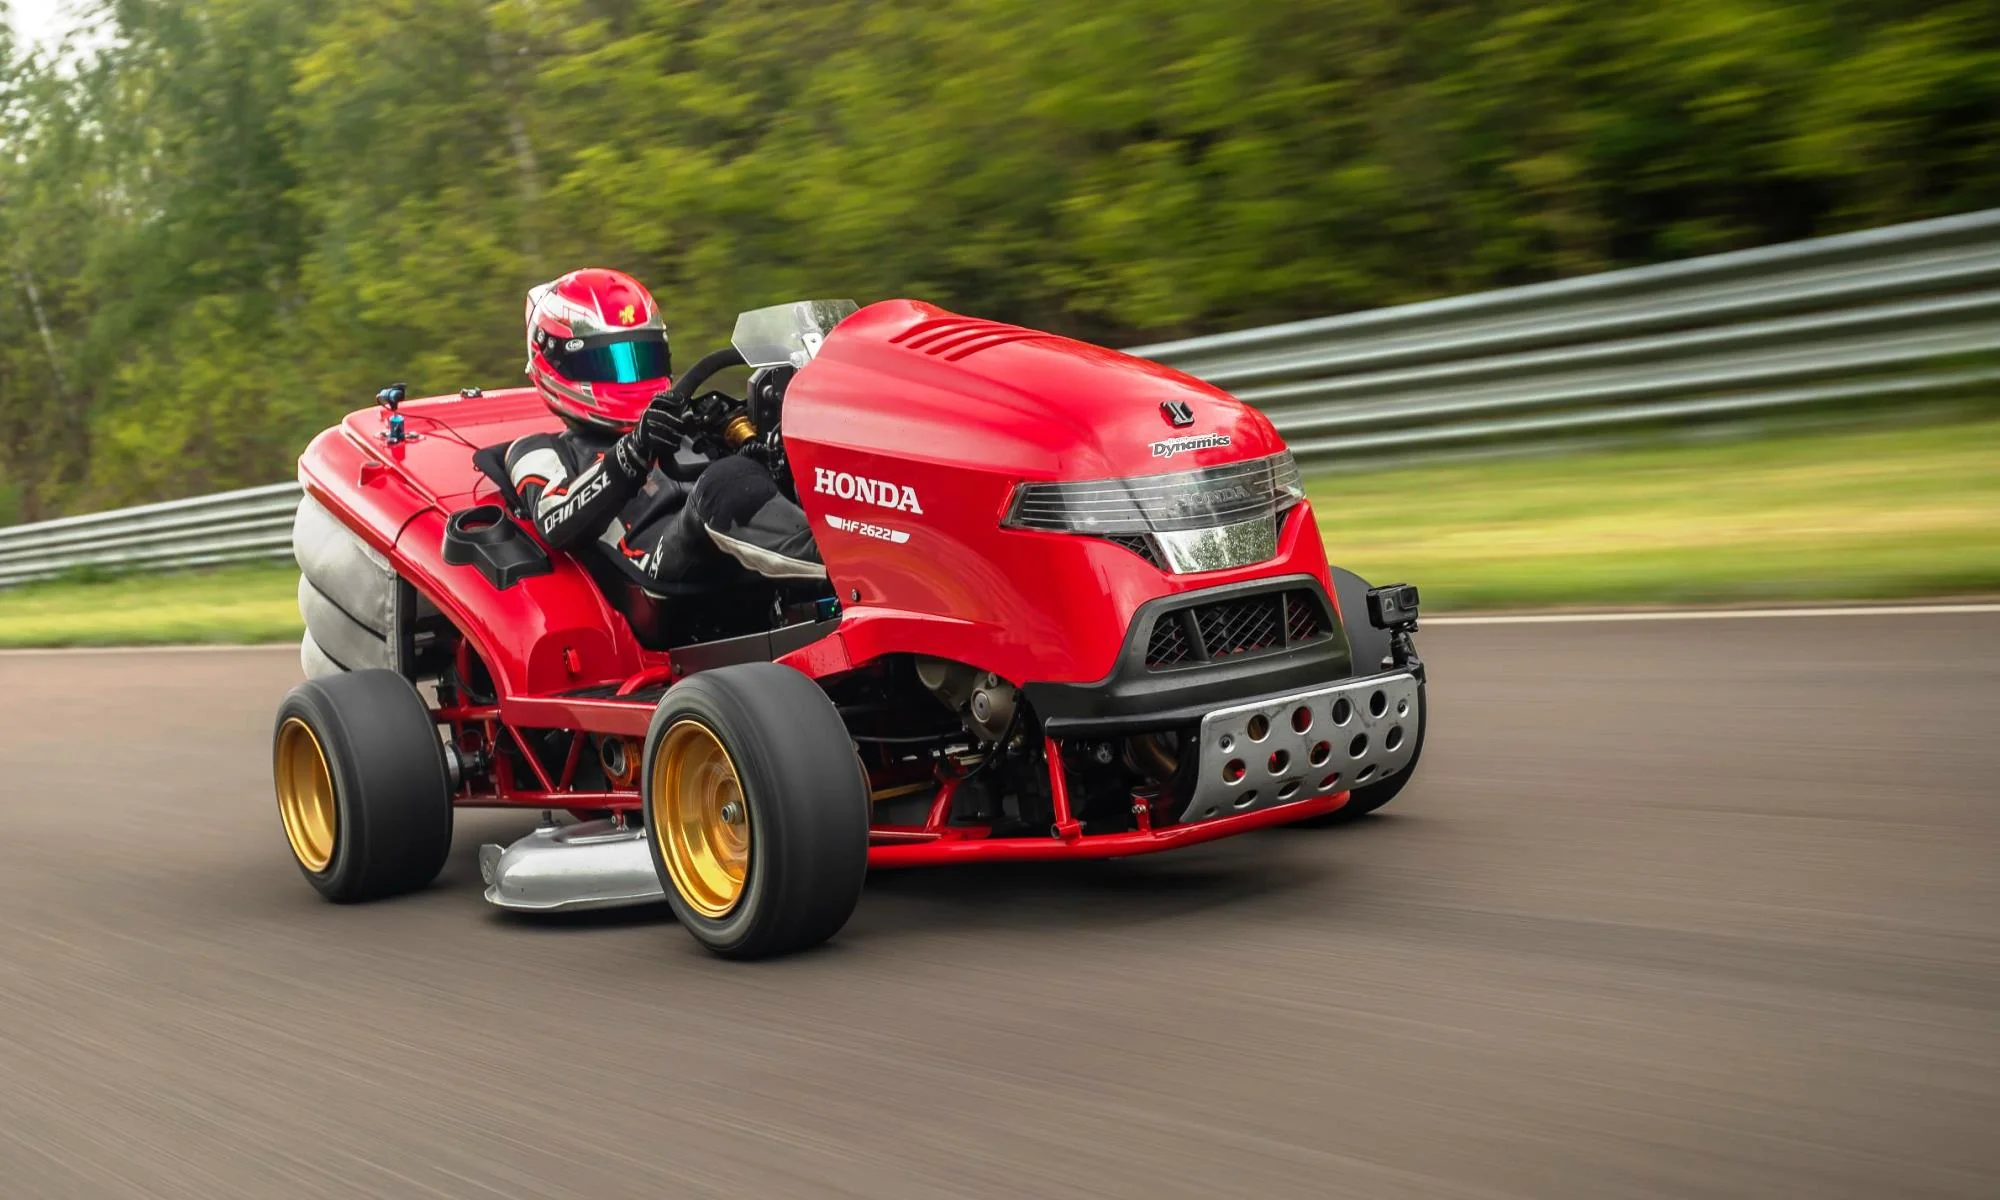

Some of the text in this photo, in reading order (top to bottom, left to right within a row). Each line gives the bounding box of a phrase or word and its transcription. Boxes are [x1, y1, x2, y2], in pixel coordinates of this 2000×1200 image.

[1151, 433, 1231, 458] Dynamics
[544, 470, 611, 535] DAINESE
[814, 466, 924, 515] HONDA
[841, 518, 892, 541] HF 2622
